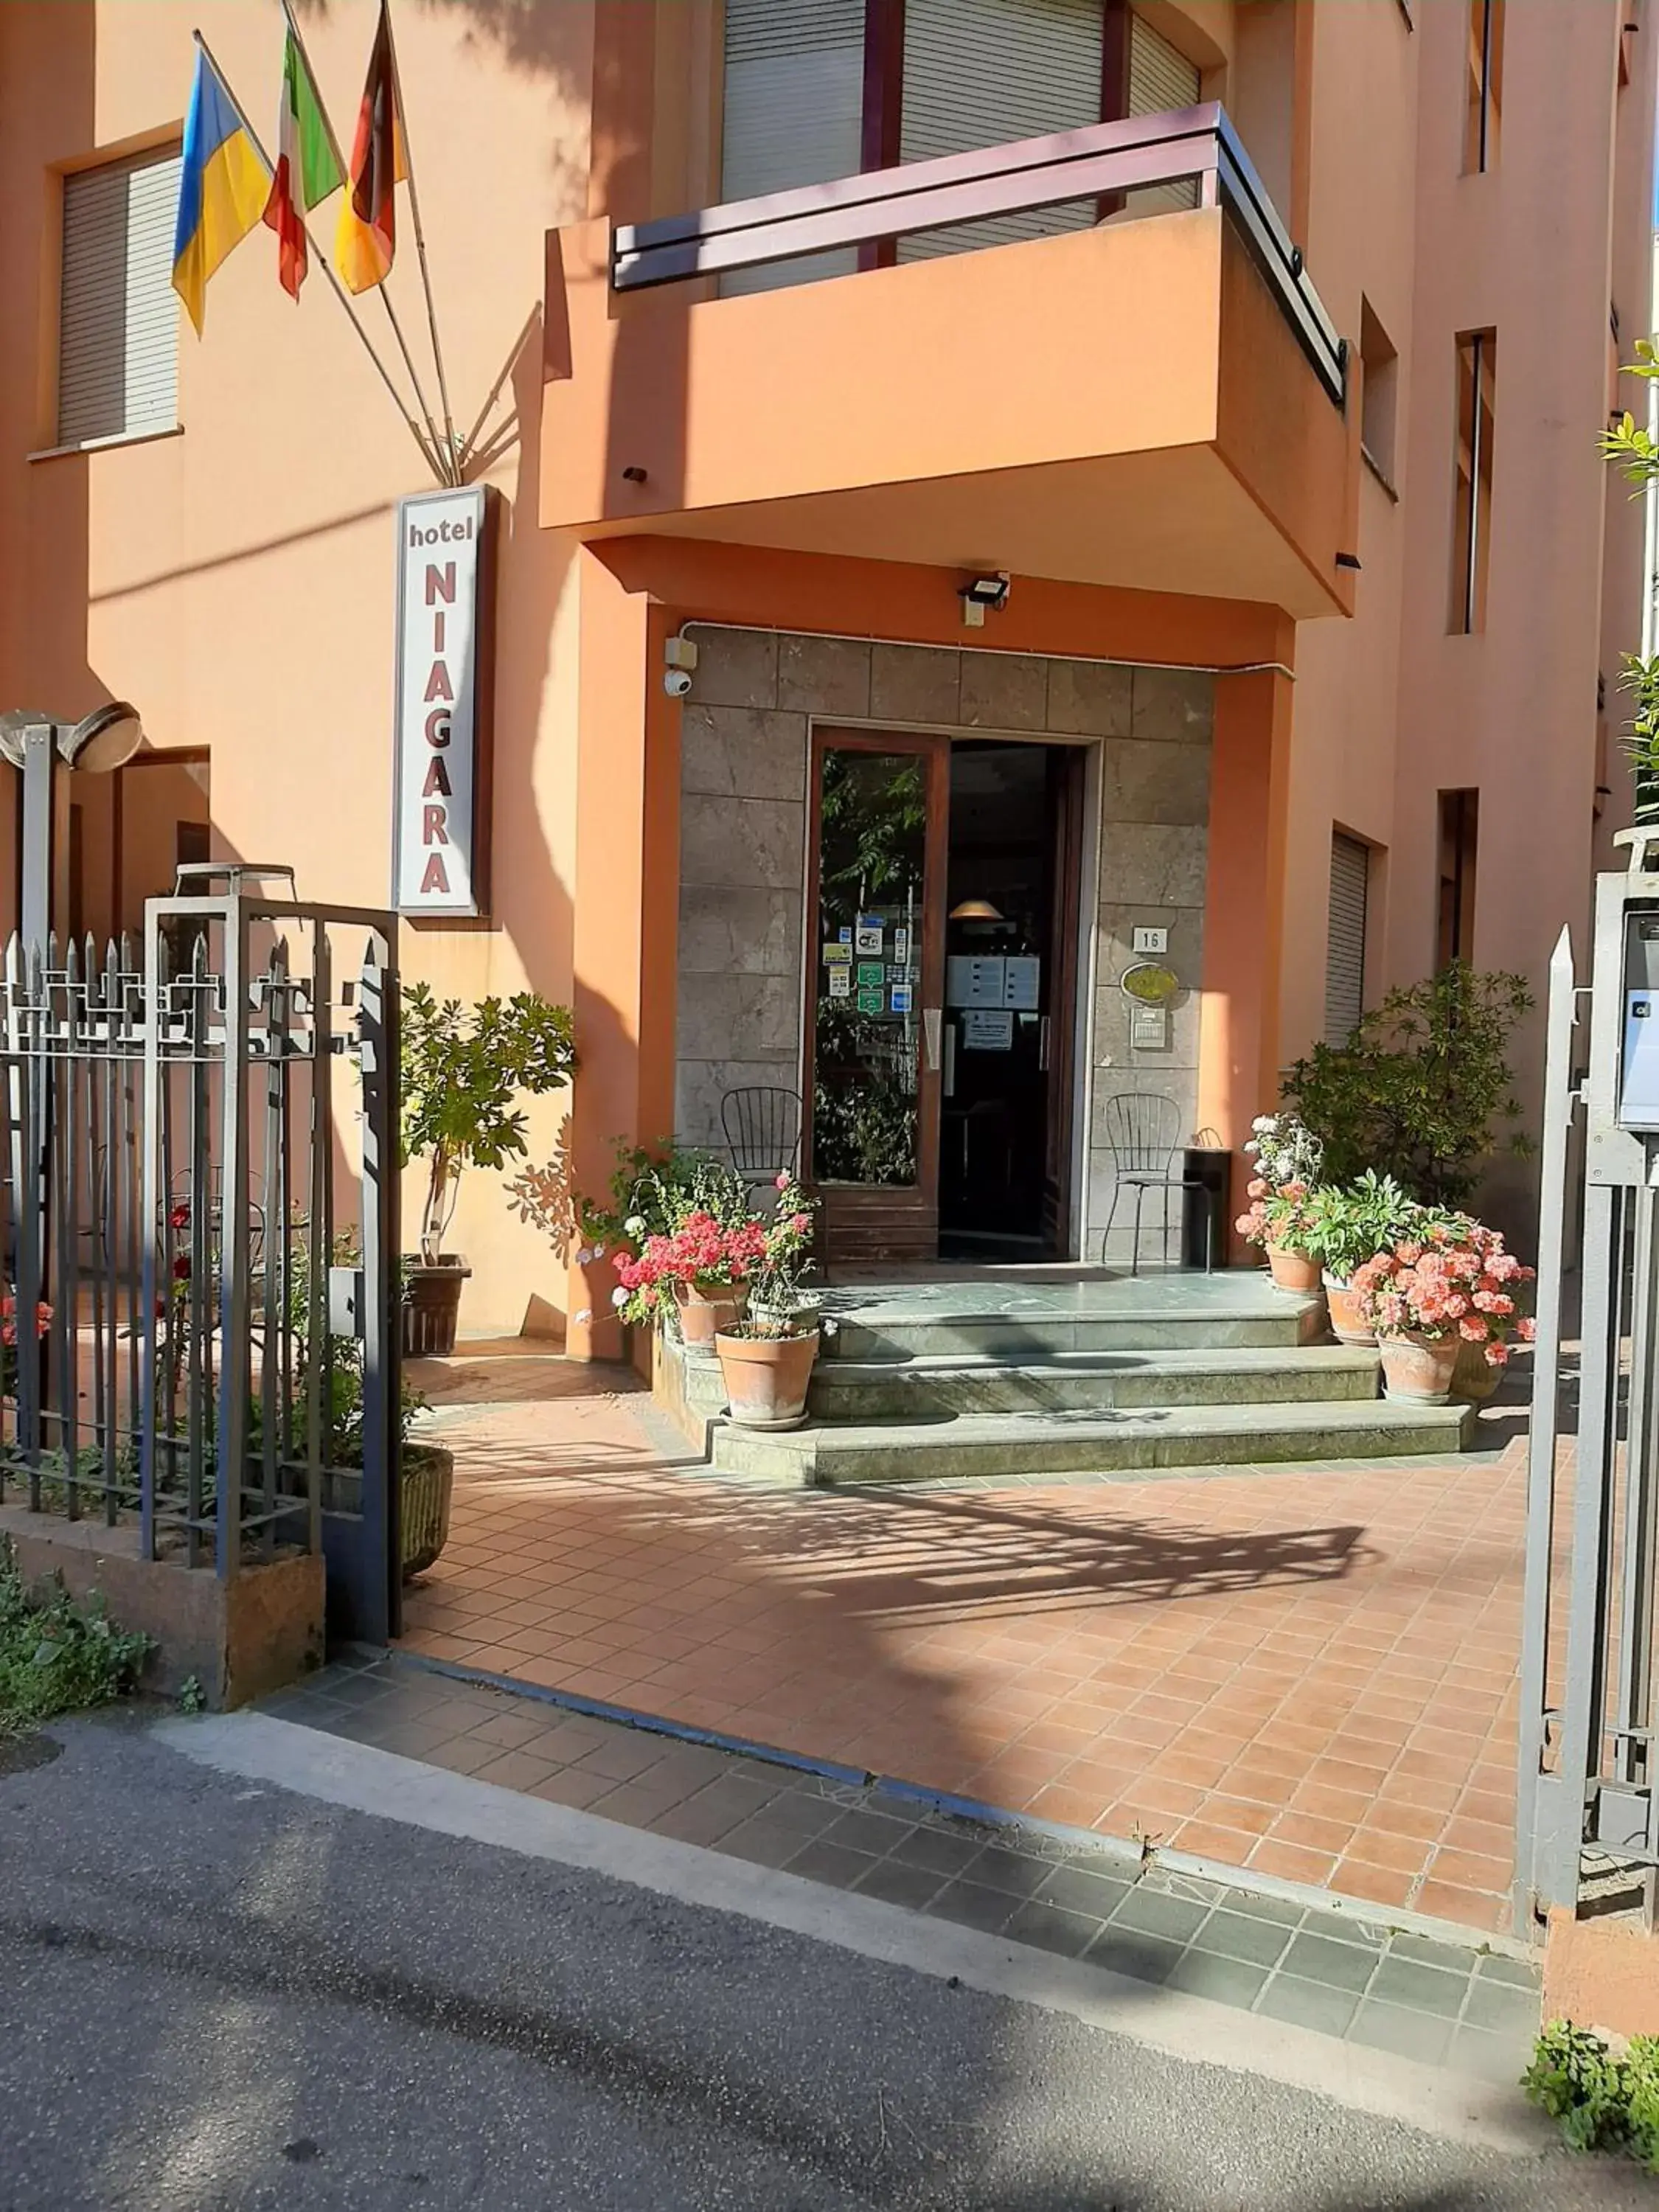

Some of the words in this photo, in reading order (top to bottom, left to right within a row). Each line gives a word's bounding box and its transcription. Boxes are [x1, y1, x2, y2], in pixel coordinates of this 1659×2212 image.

[408, 516, 473, 548] hotel
[420, 561, 456, 894] NIAGARA
[1144, 933, 1159, 948] 16
